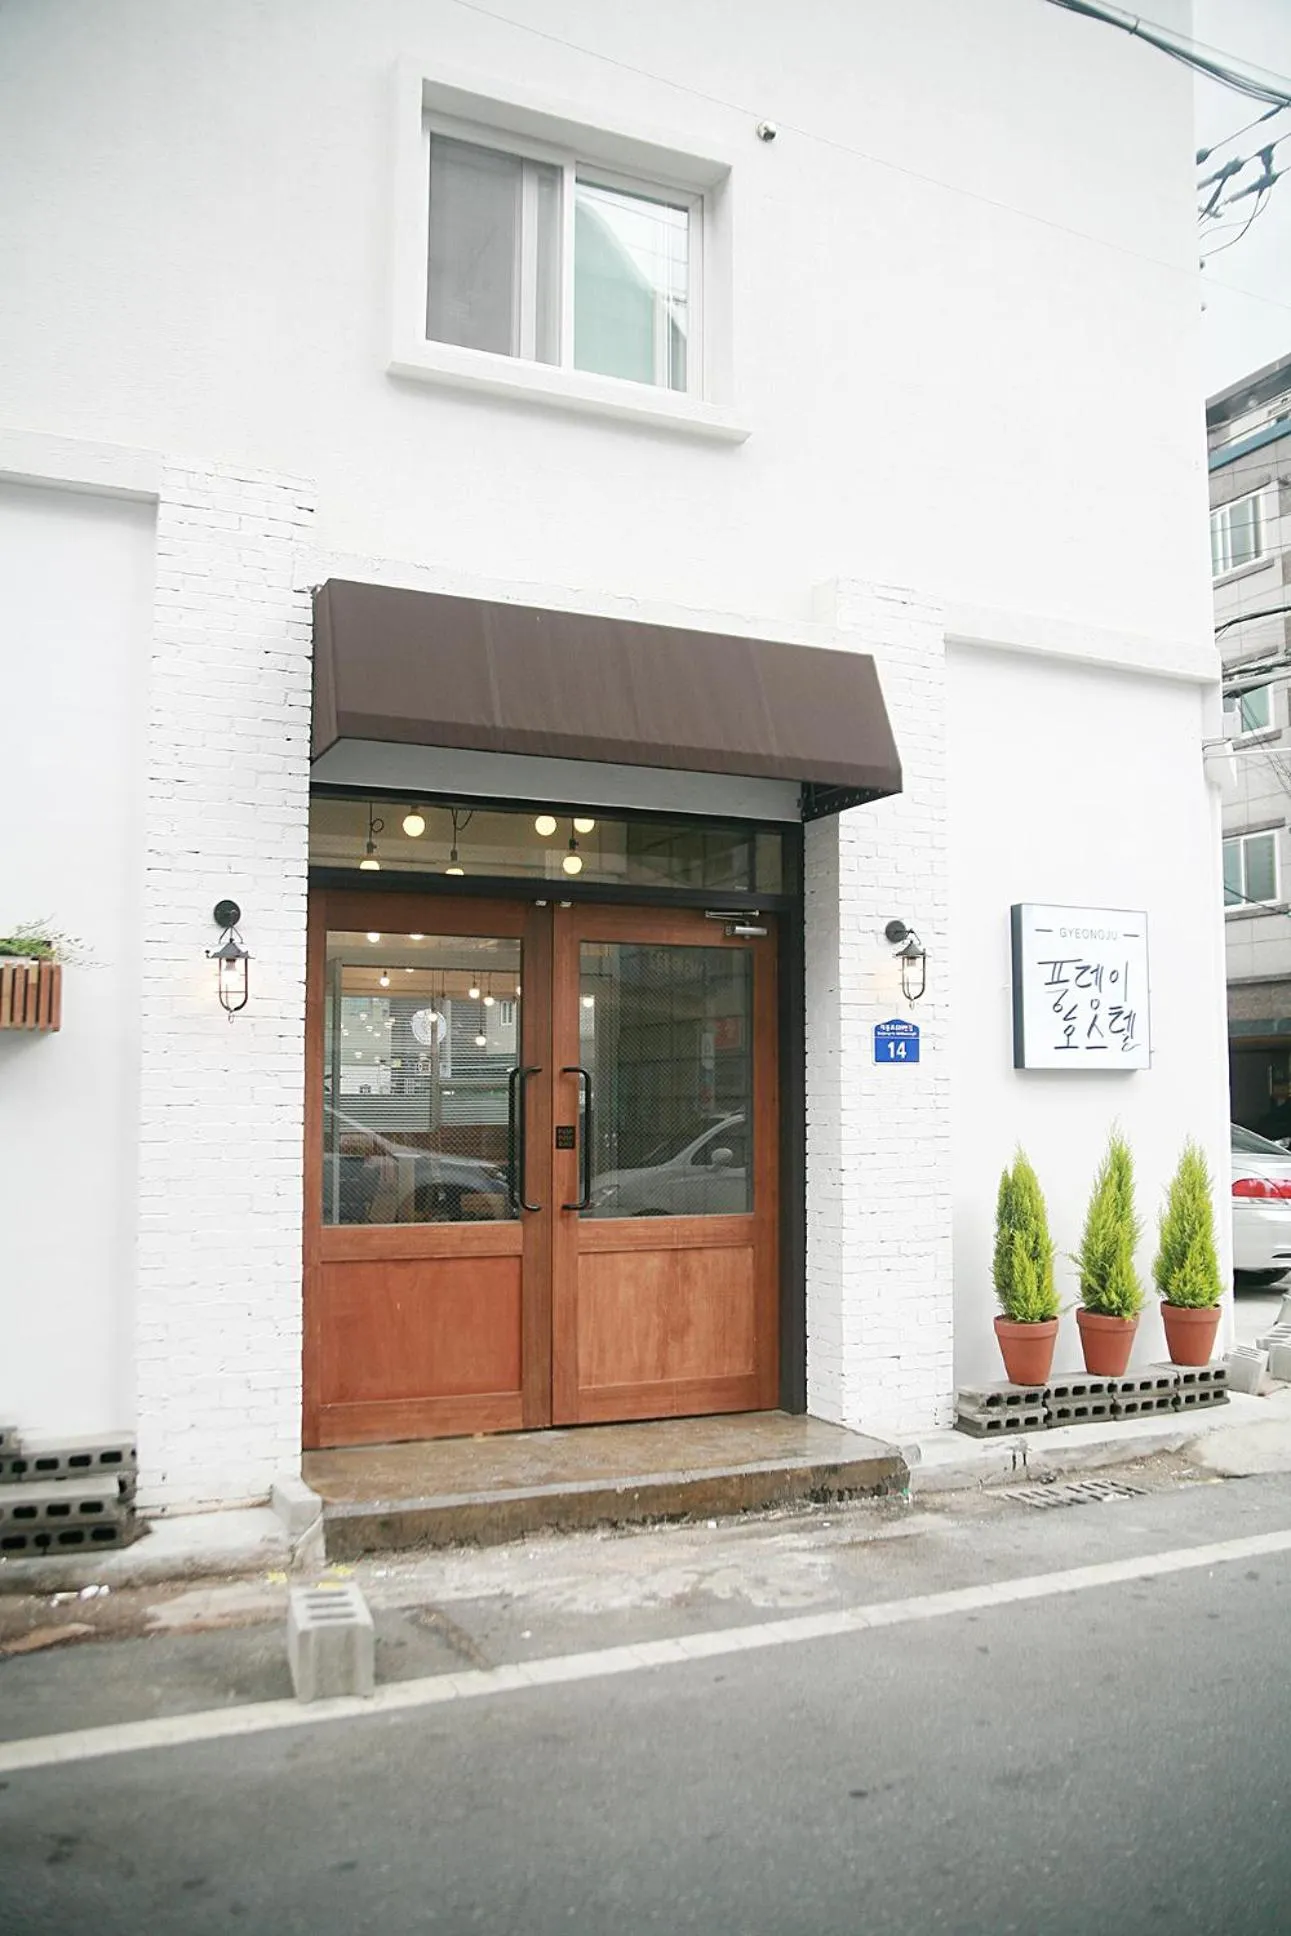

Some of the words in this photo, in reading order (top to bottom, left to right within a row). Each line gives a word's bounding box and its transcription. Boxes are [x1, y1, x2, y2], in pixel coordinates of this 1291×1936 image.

[1059, 927, 1119, 941] GYEONGJU
[1053, 1003, 1139, 1052] 호스텔
[887, 1041, 907, 1059] 14
